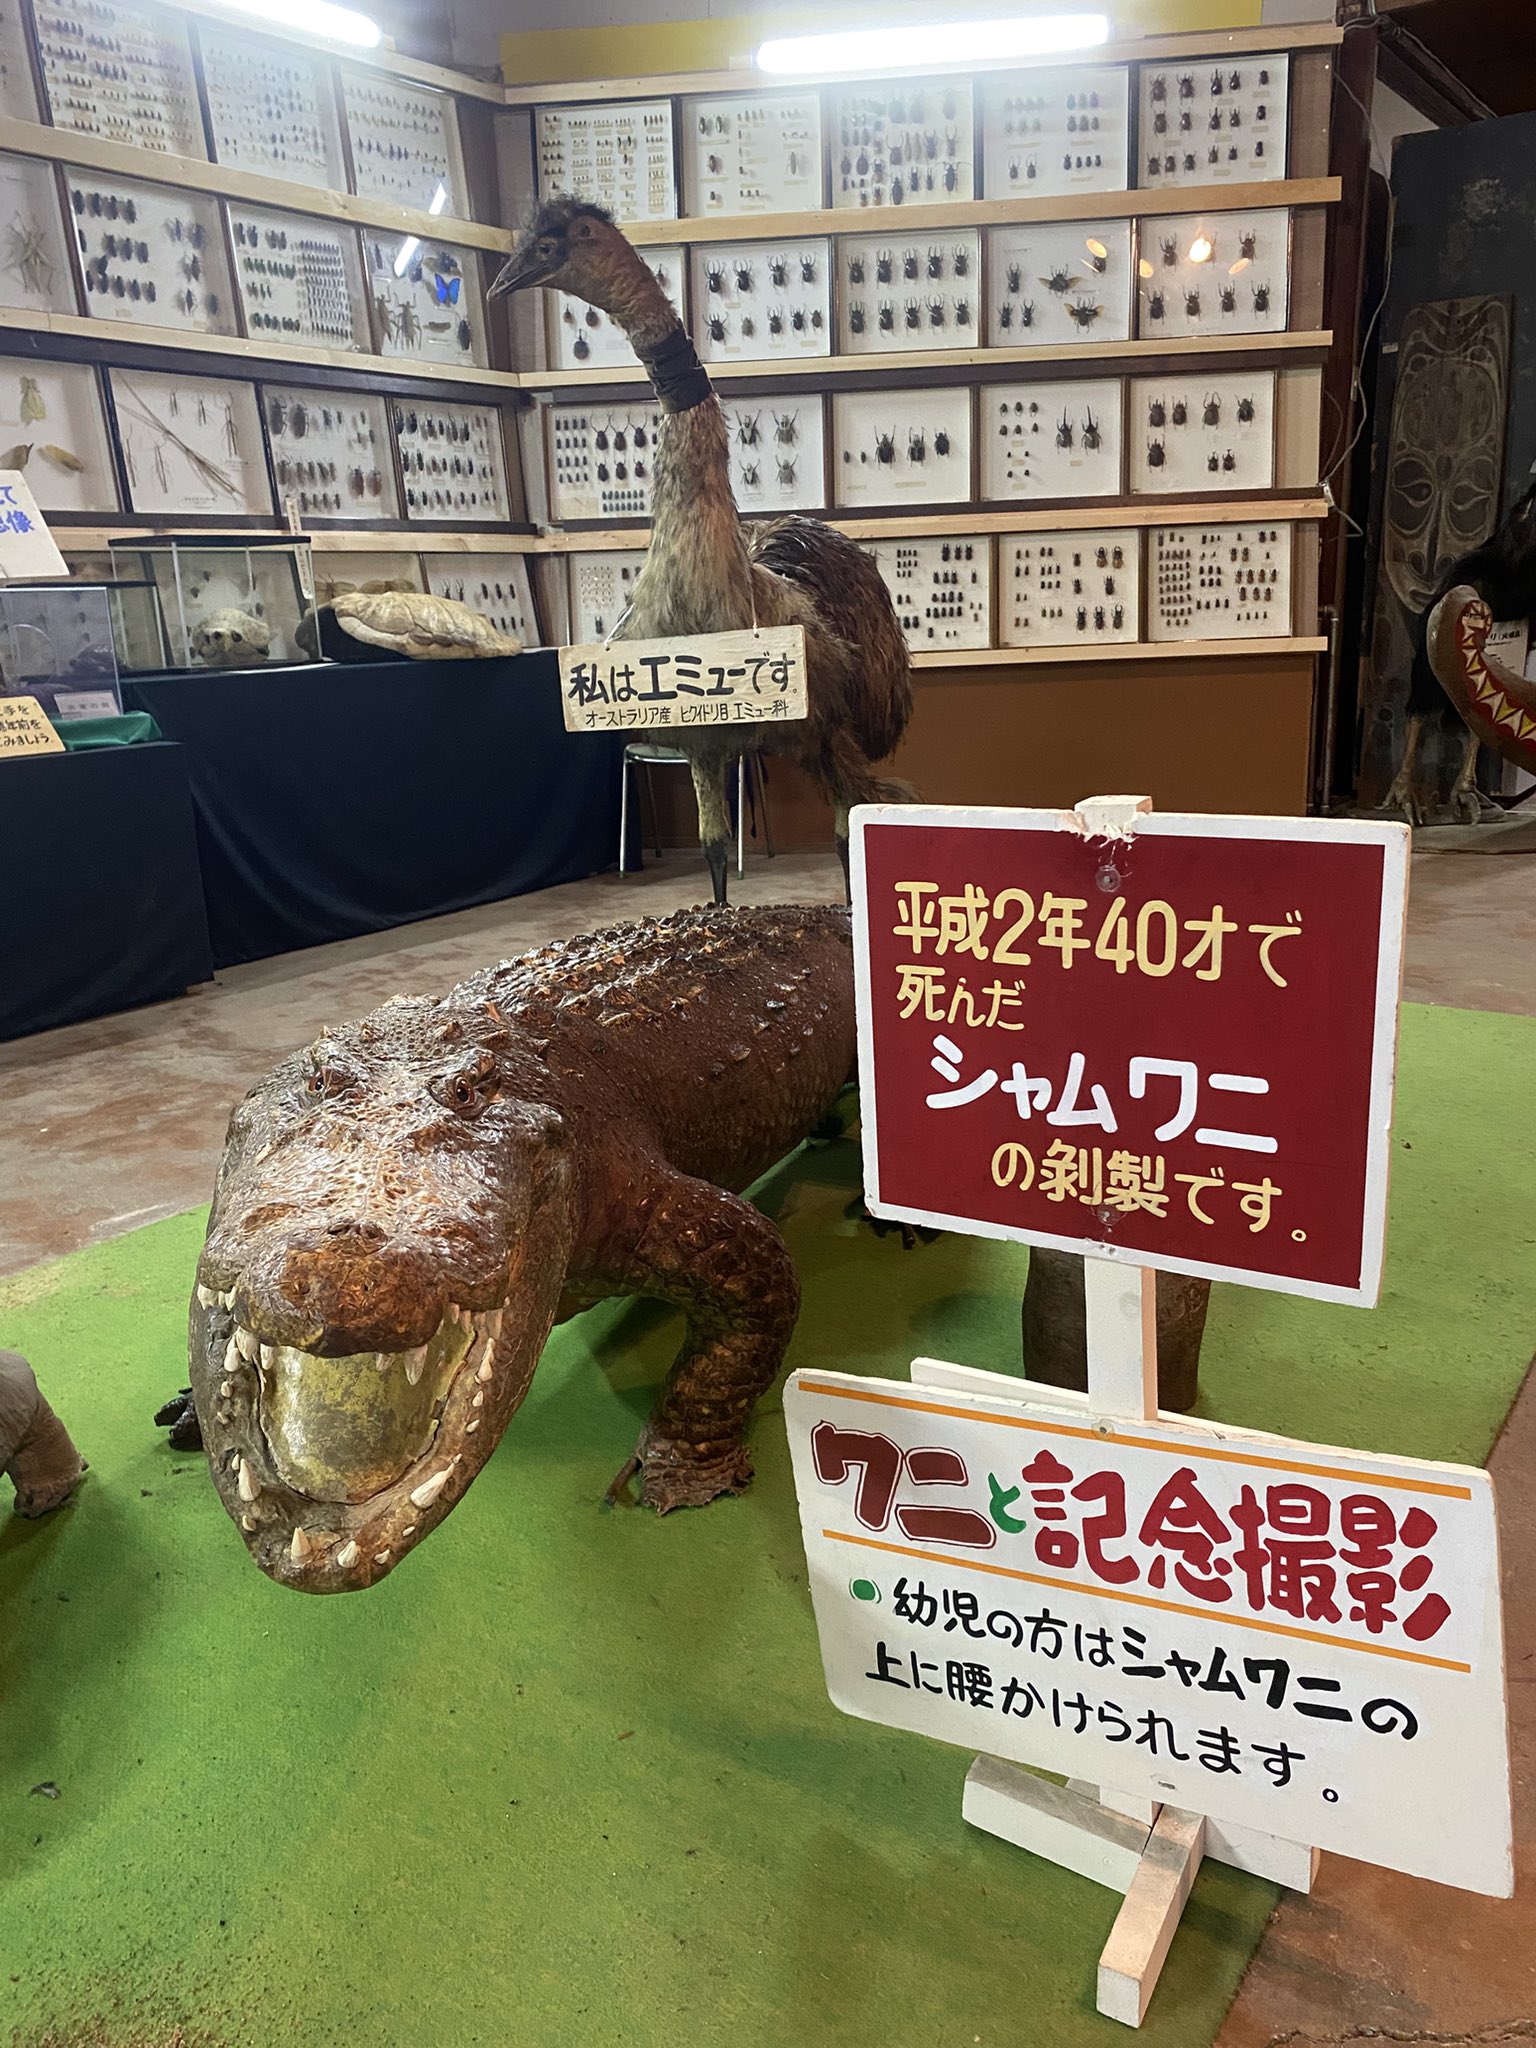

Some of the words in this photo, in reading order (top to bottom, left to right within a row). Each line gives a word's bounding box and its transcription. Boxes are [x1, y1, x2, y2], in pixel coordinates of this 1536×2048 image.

[568, 651, 798, 706] 私はエミューです。
[585, 706, 672, 728] オーストラリア産
[680, 703, 729, 723] ヒクイドリ目
[733, 698, 789, 720] エミュー科
[892, 880, 1304, 988] 平成2年40才で
[895, 964, 1026, 1031] 死んだ
[925, 1034, 1279, 1154] シャムワニ
[810, 1420, 1453, 1643] ワニと記念撮影
[892, 1576, 1420, 1741] 幼児の方はシャムワニの
[866, 1640, 1341, 1804] 上に腰かけられます。
